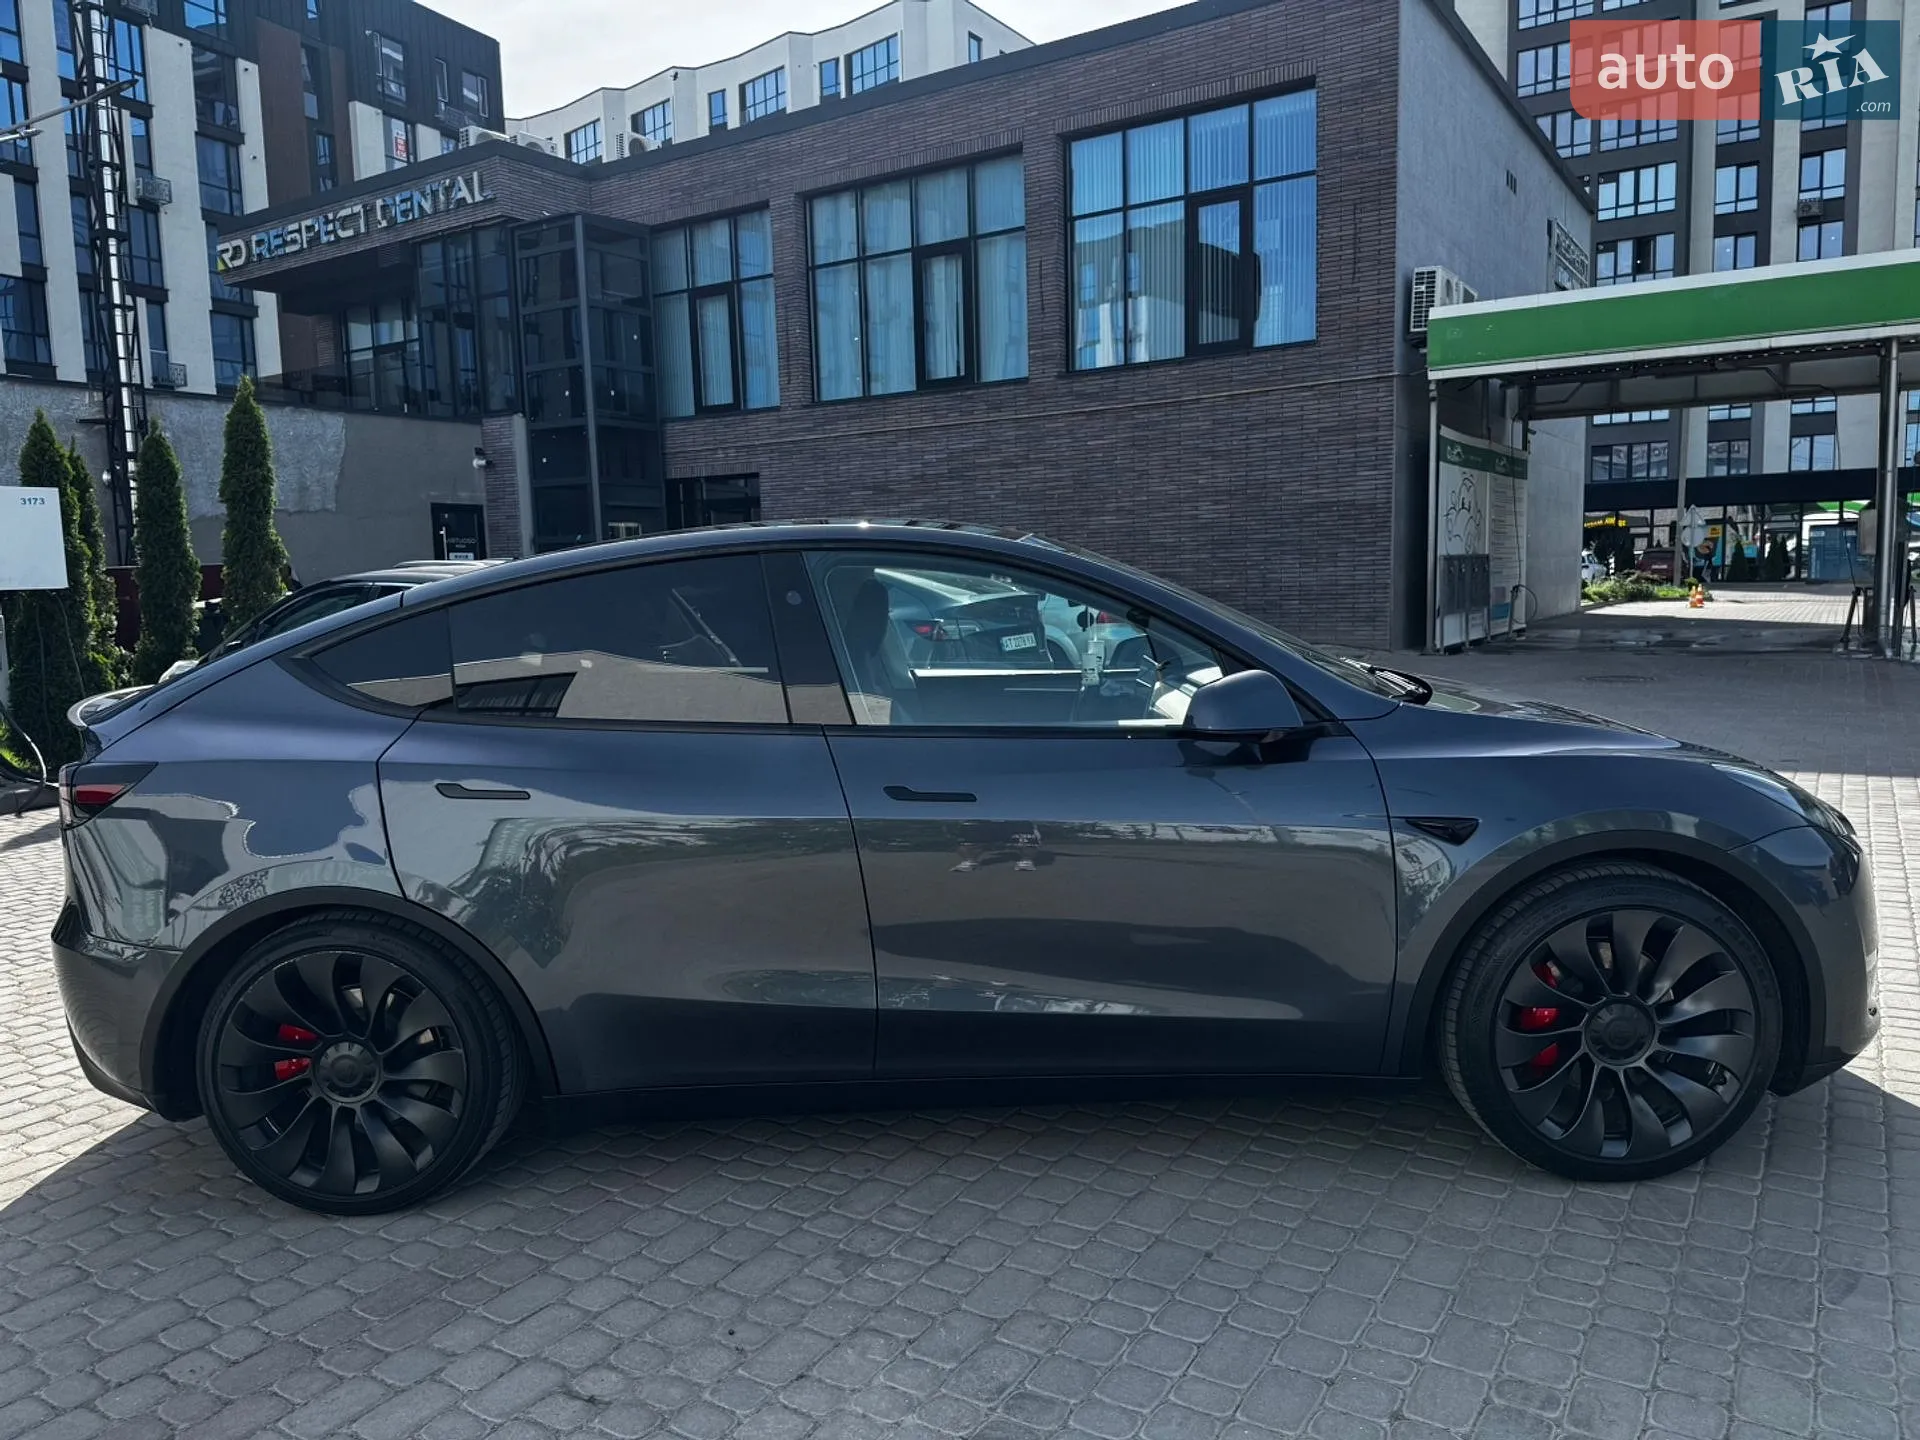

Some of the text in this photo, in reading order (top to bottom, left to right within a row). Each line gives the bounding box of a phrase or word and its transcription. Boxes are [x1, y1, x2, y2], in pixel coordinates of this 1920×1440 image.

[251, 204, 371, 262] RESPECT
[376, 171, 494, 229] DENTAL
[20, 497, 46, 505] 3173
